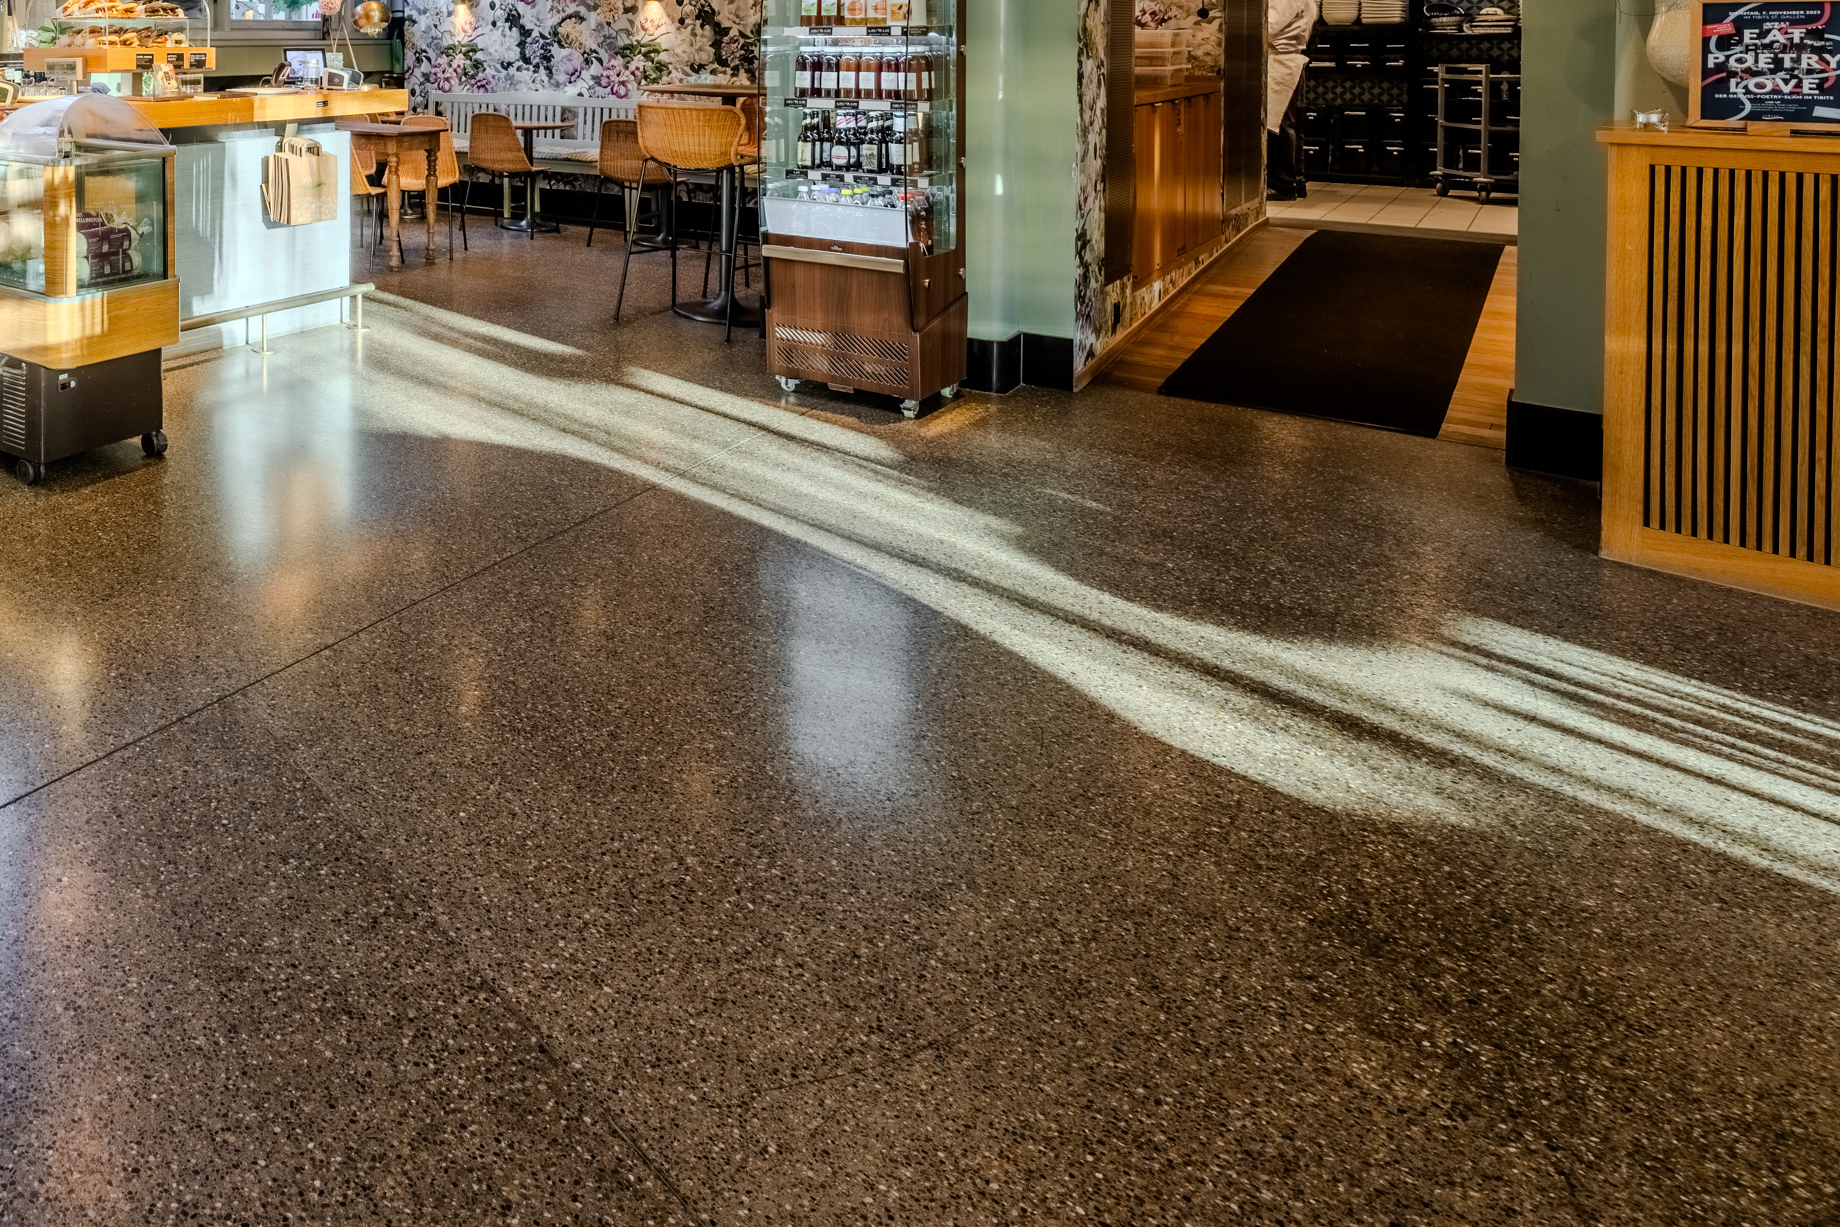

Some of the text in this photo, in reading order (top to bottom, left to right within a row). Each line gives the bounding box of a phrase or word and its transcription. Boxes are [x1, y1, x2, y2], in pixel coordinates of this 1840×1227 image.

[1743, 28, 1806, 44] EAT
[1707, 54, 1840, 69] POETRY
[1730, 78, 1819, 94] LOVE
